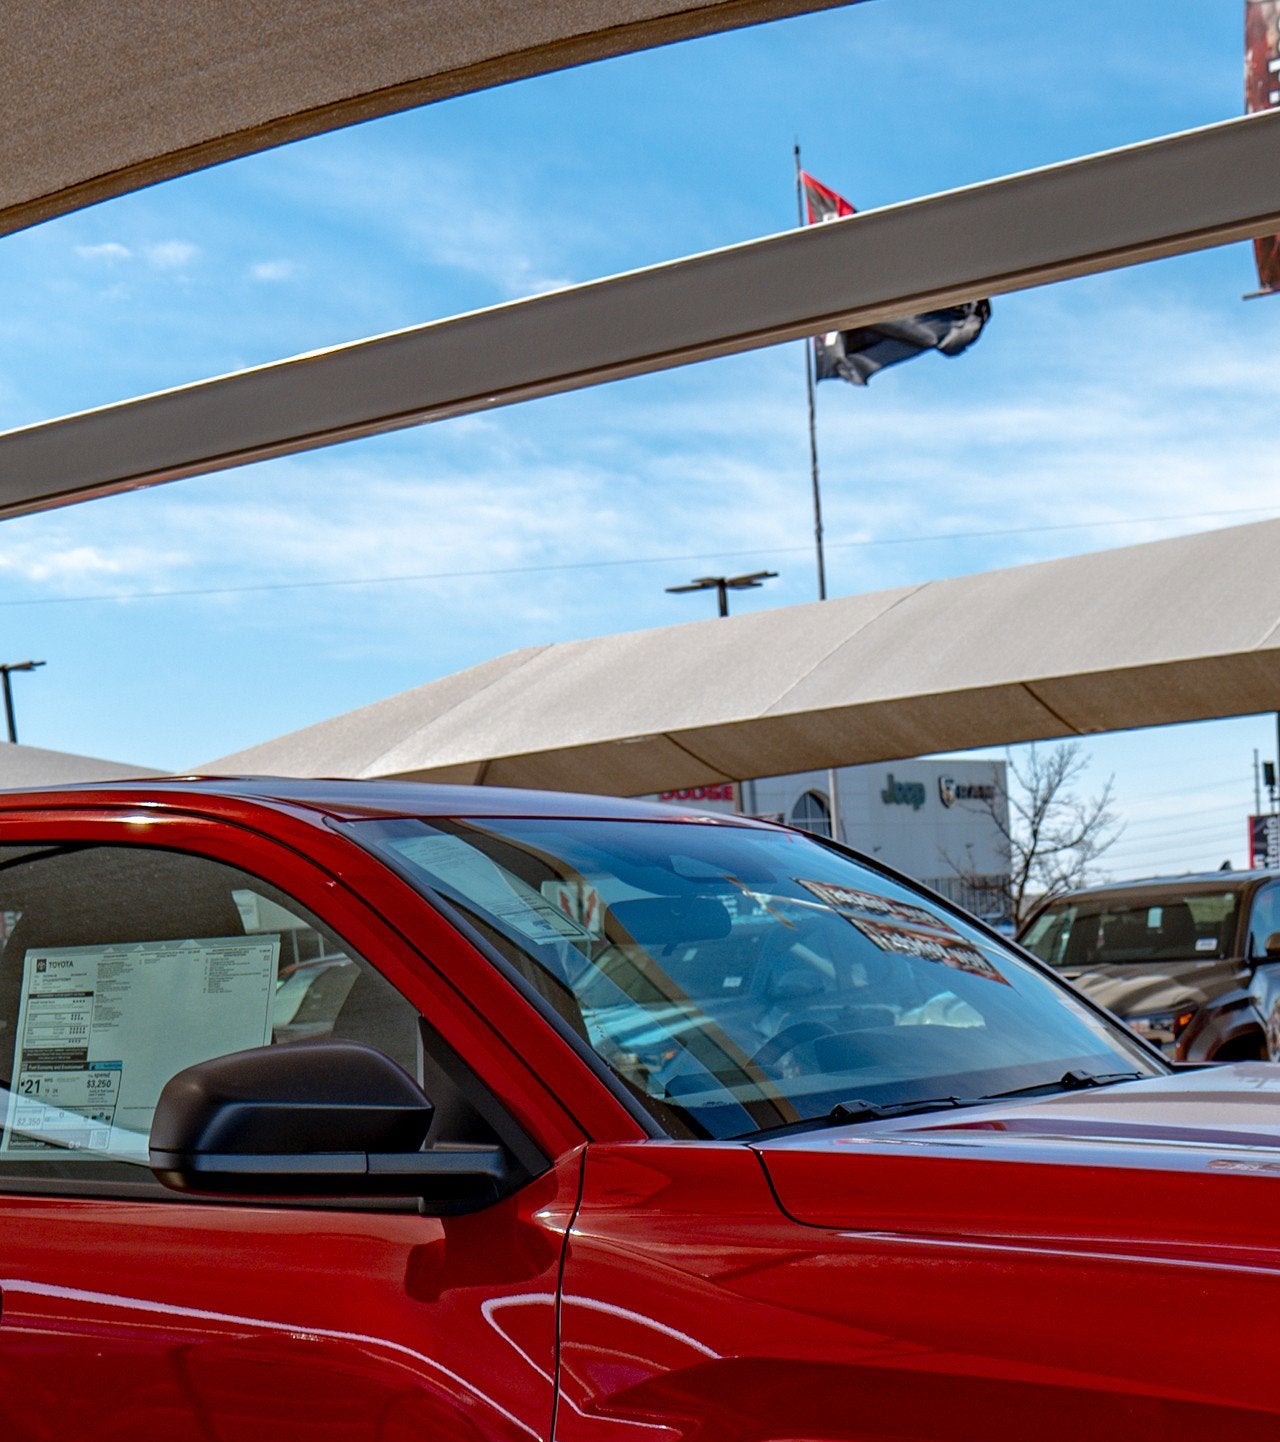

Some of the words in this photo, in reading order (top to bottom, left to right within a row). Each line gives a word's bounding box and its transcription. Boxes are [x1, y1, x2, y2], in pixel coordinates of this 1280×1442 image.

[881, 773, 926, 812] Jeep
[48, 960, 74, 969] TOYOTA
[24, 1079, 41, 1094] 21
[86, 1079, 111, 1089] $3,250
